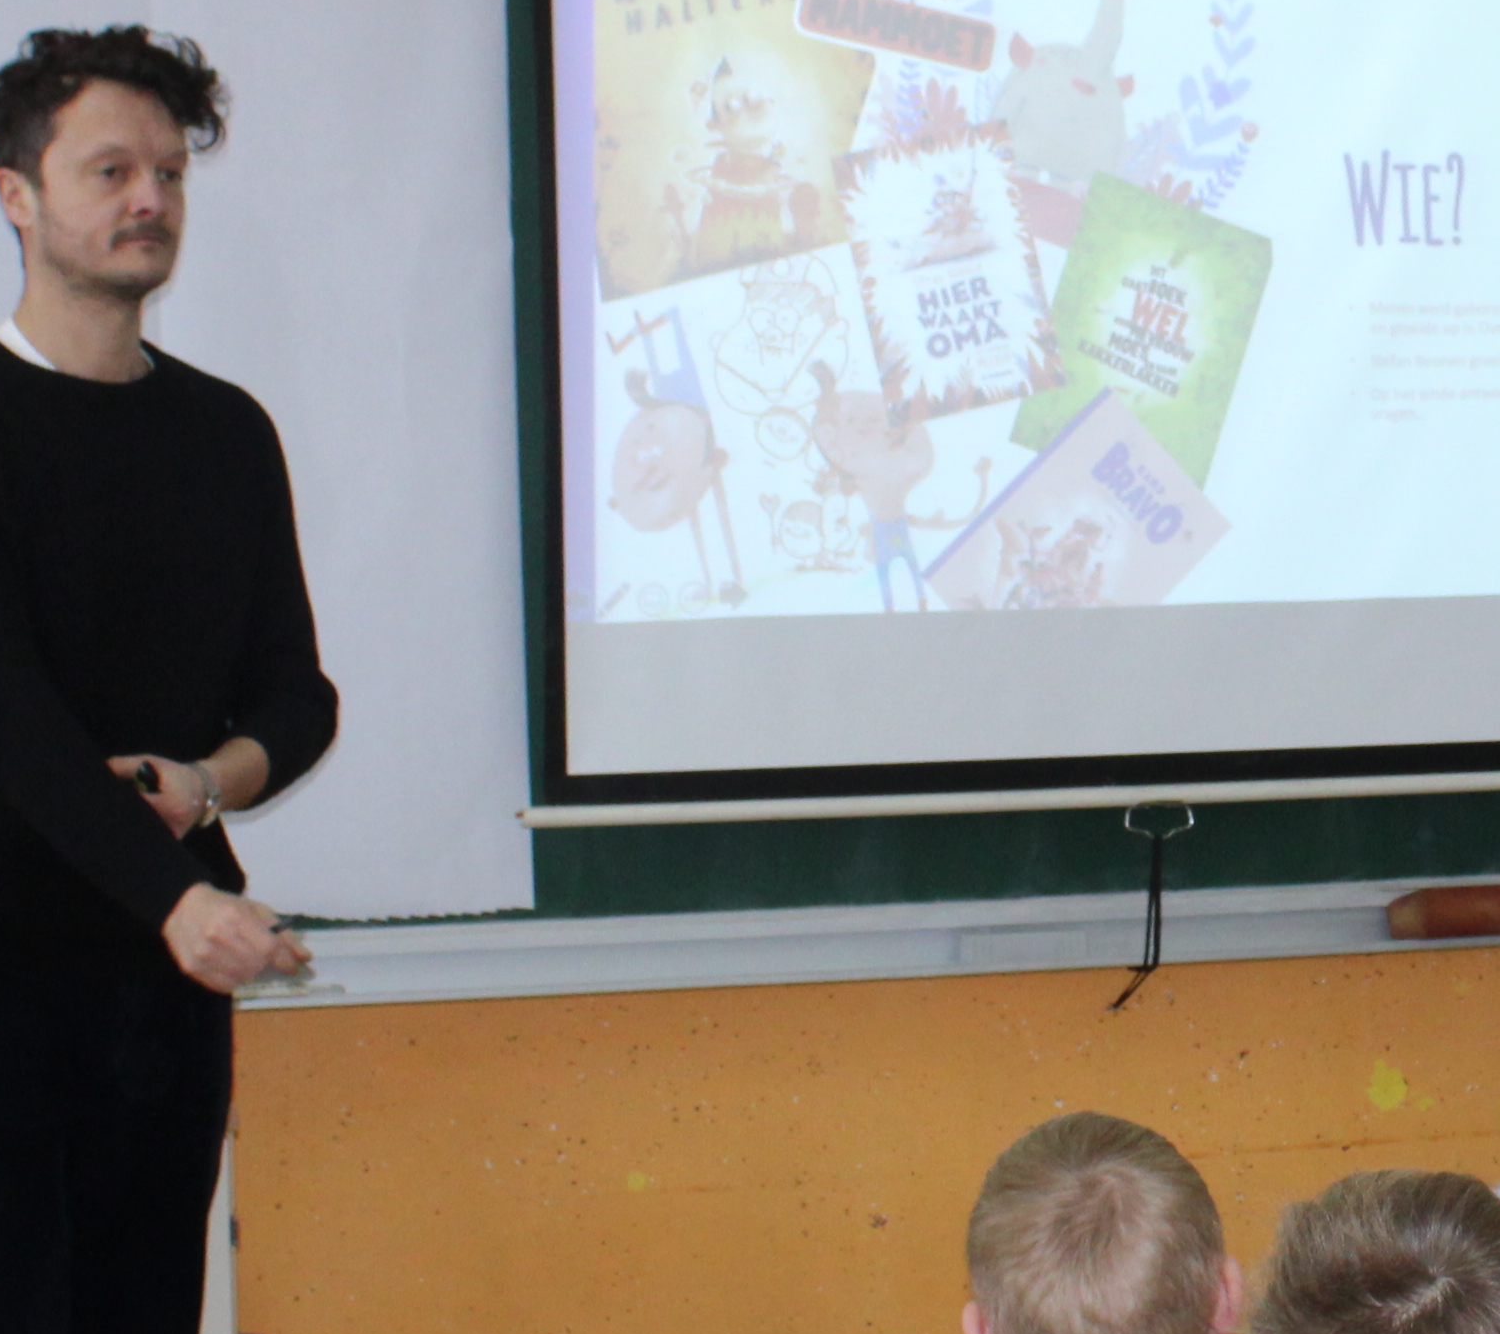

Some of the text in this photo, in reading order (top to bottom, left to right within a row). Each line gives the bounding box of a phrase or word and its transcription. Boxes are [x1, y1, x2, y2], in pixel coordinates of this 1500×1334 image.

[1343, 148, 1465, 248] WIE?
[918, 277, 992, 314] HIER
[918, 299, 1002, 330] WAAKT
[1132, 282, 1189, 346] WEL
[926, 318, 1009, 360] OMA
[1090, 440, 1184, 545] BRAVO
